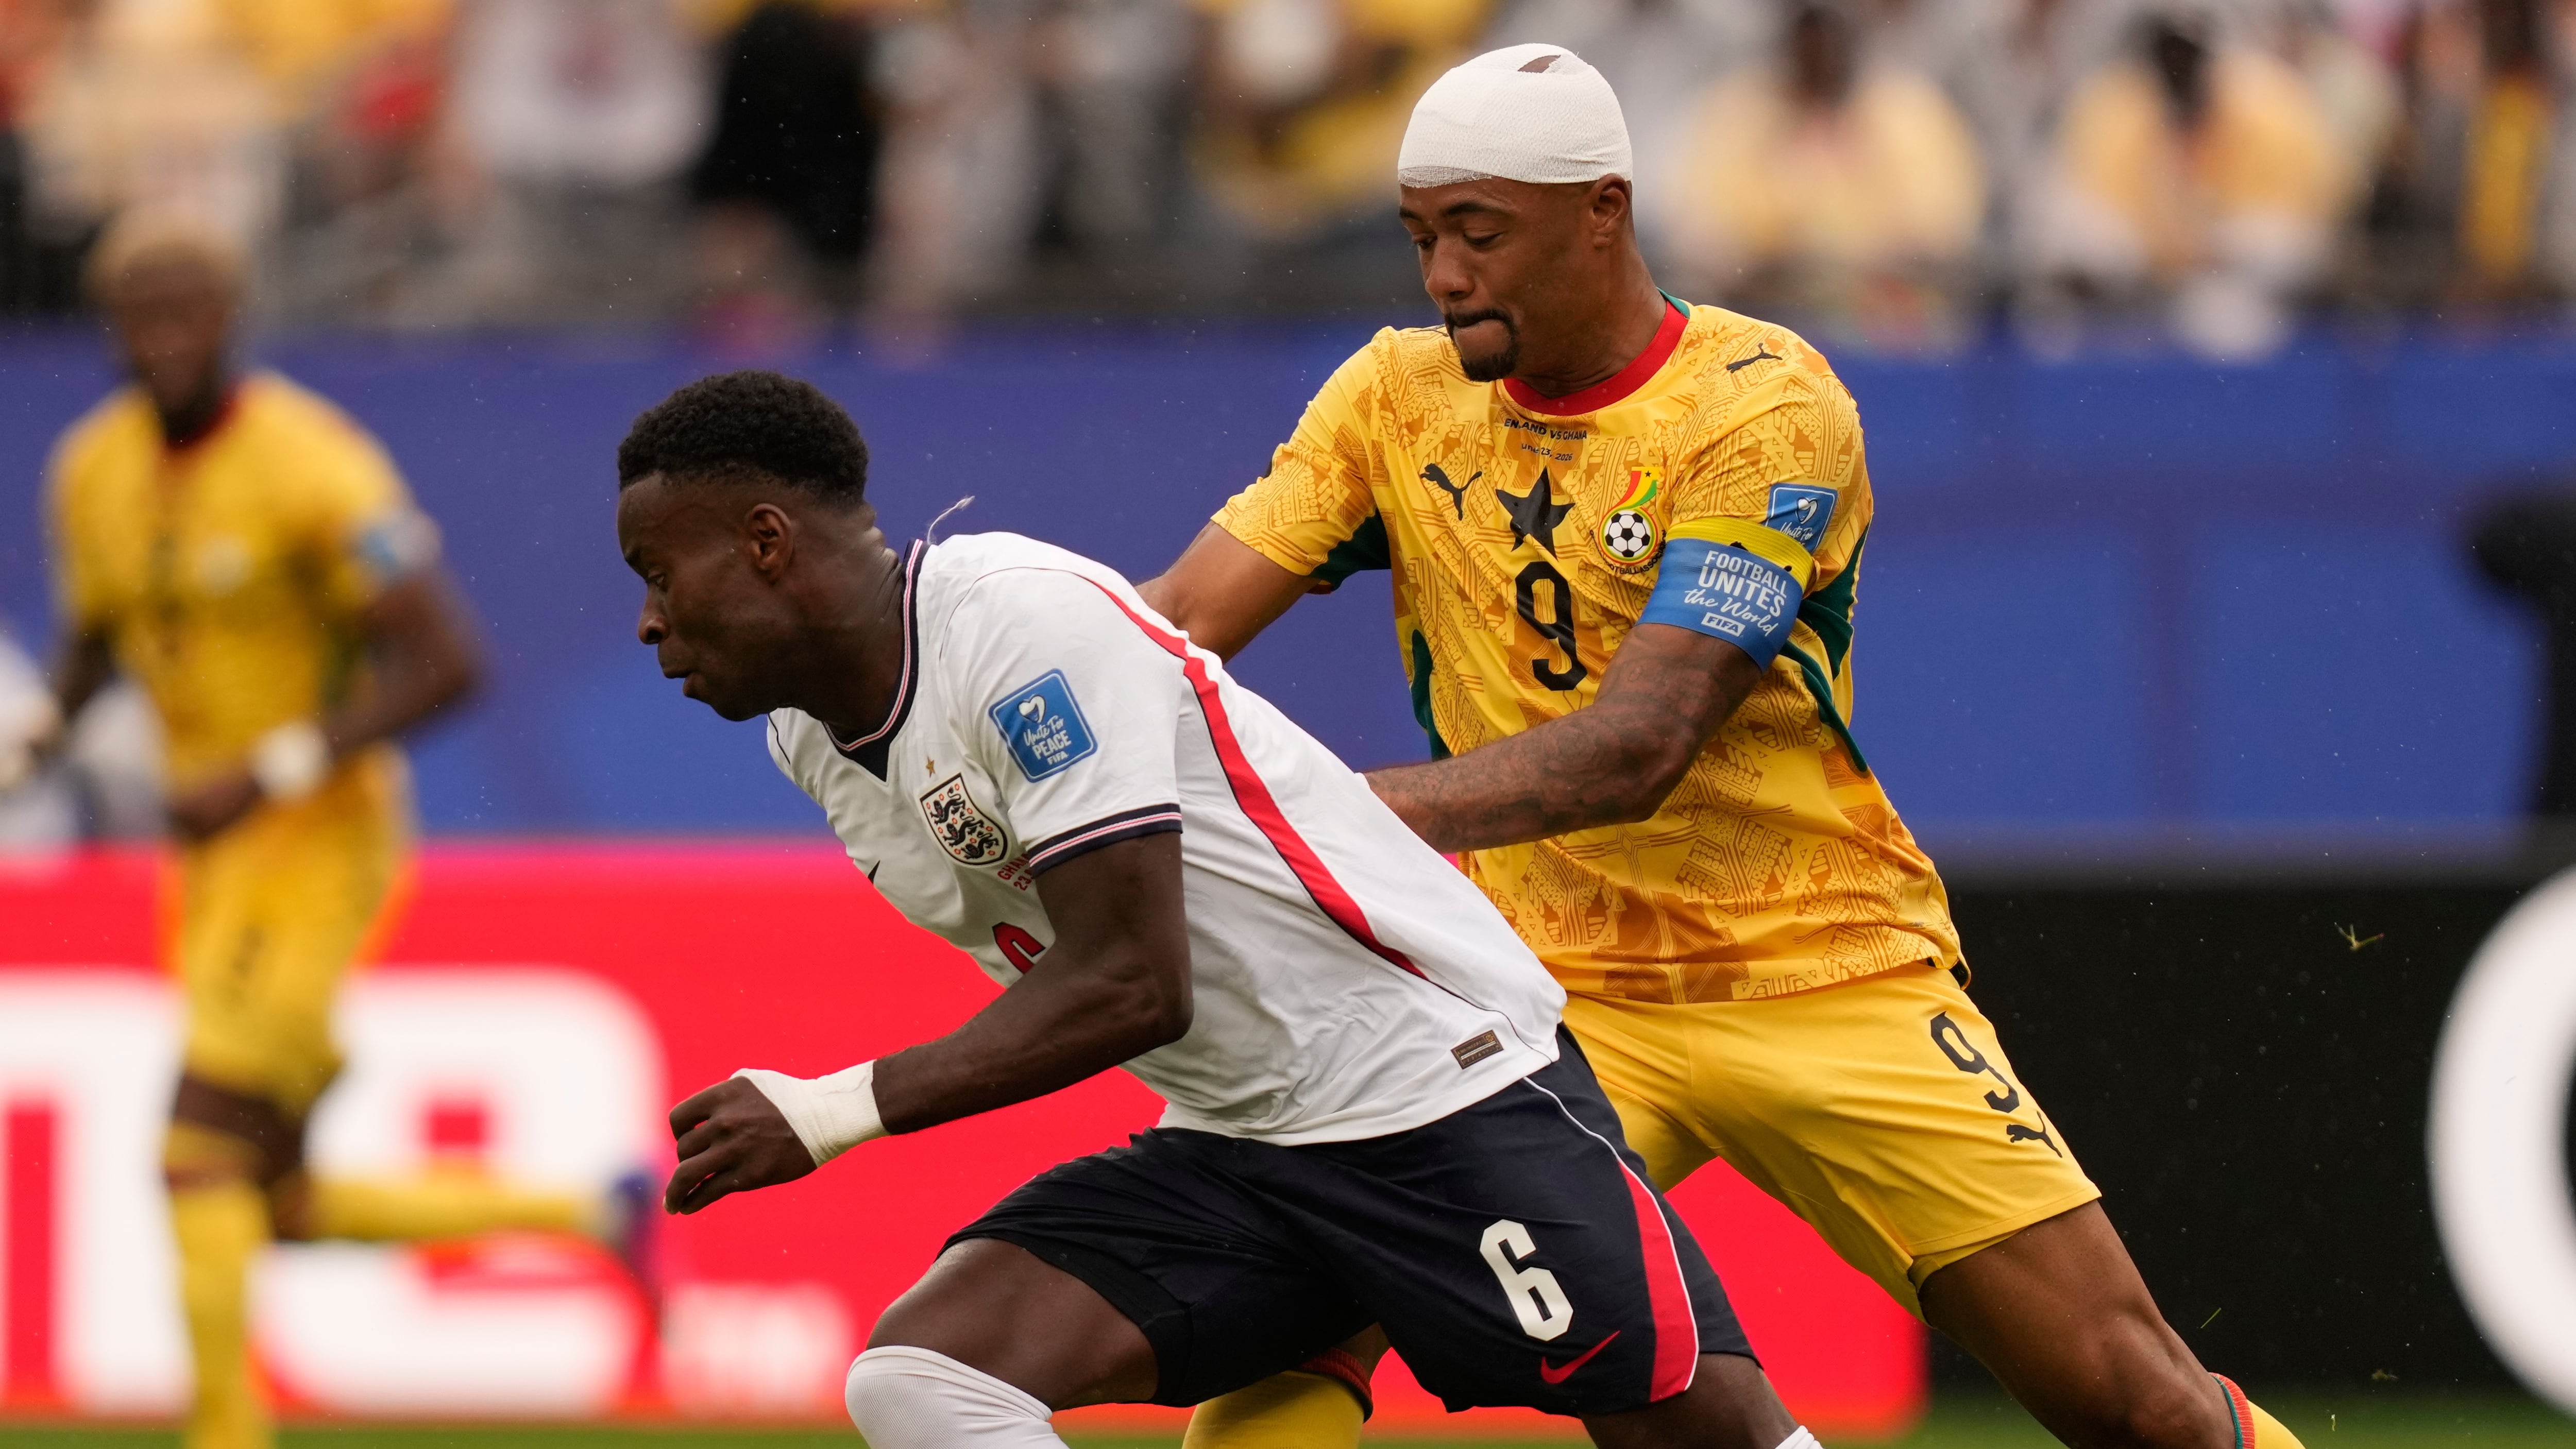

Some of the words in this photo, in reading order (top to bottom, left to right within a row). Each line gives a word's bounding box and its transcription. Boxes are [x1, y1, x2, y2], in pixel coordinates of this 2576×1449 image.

[1504, 418, 1547, 435] ENAND
[1550, 430, 1562, 439] VS
[1563, 430, 1587, 440] GHANA
[1521, 443, 1539, 454] une
[1555, 453, 1573, 461] 2026
[1801, 527, 1814, 541] For
[1704, 550, 1787, 599] FOOTBALL
[1698, 566, 1785, 618] UNITES
[1514, 560, 1588, 691] 9
[1684, 588, 1719, 607] the
[1720, 596, 1779, 637] World
[1706, 616, 1740, 634] FIFA
[1023, 724, 1050, 747] Unite
[1047, 715, 1064, 734] For
[1032, 729, 1072, 760] PEACE
[1047, 751, 1070, 765] FIFA
[1930, 1011, 2020, 1113] 9
[1479, 1219, 1573, 1341] 6
